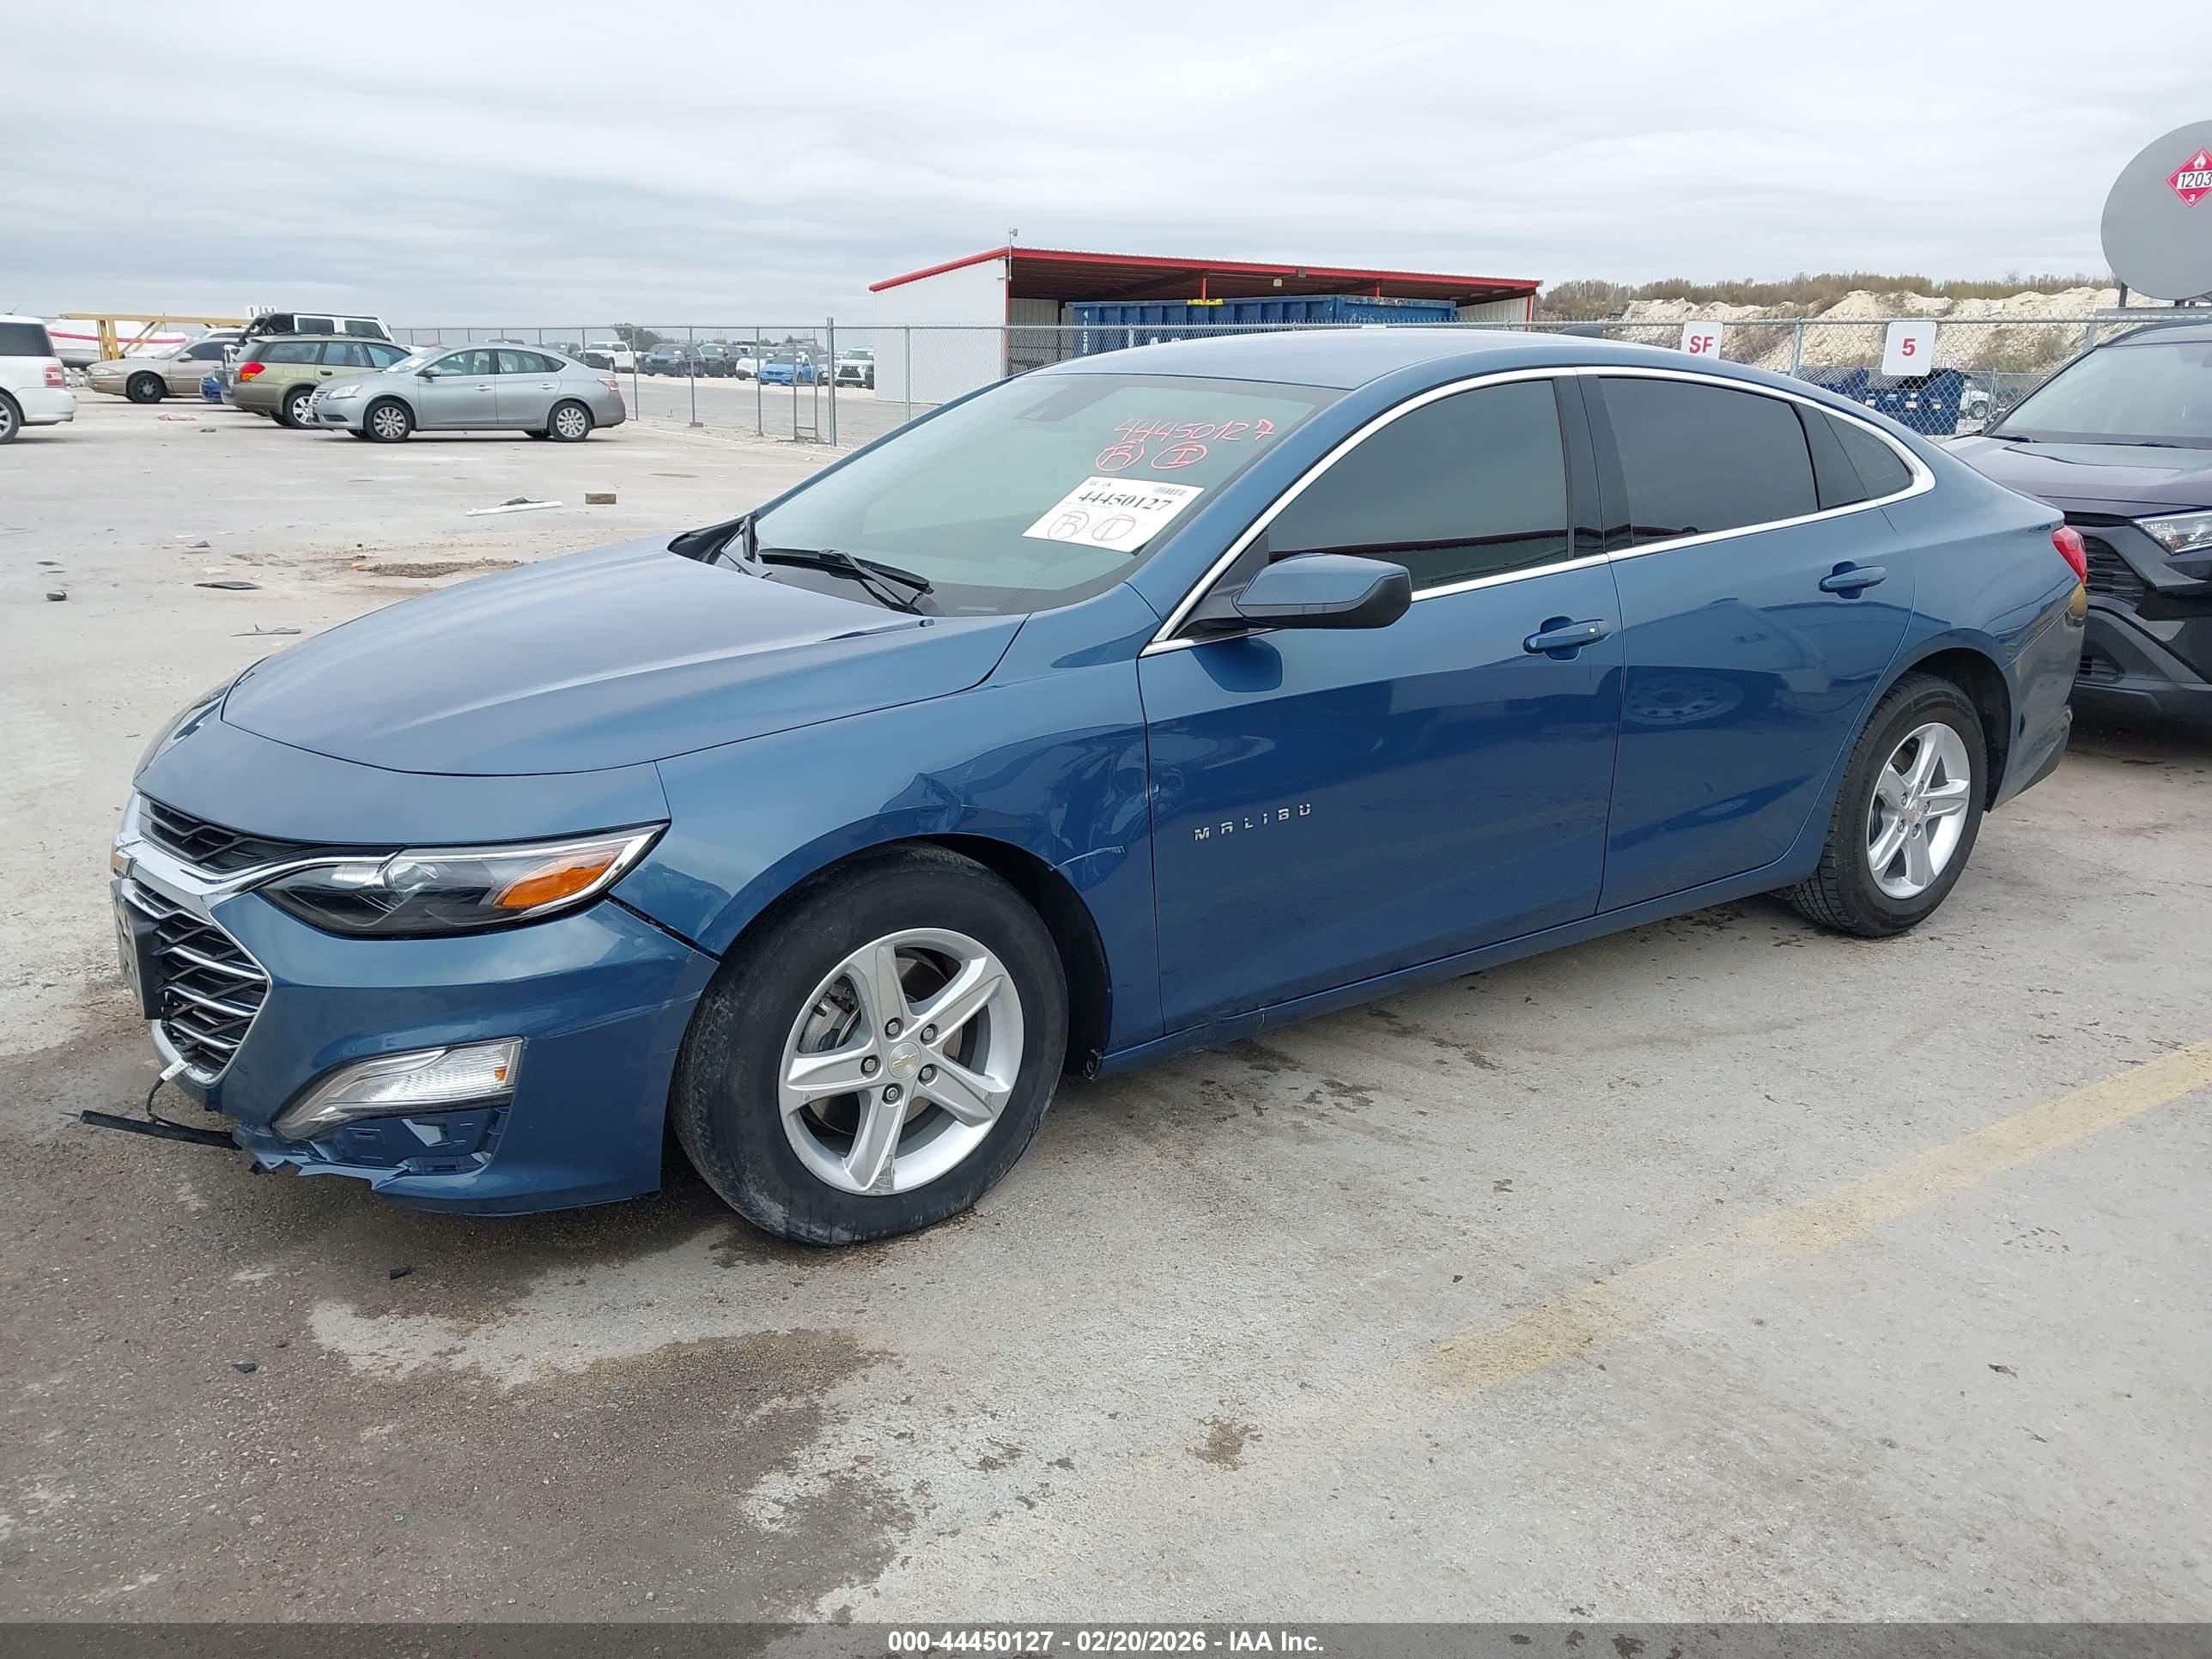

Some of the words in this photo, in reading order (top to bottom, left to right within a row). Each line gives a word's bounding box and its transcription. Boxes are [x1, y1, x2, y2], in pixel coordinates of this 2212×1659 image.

[2181, 172, 2212, 188] 1203
[2188, 193, 2196, 203] 3
[1689, 335, 1714, 354] SF
[1902, 337, 1917, 356] 5
[1079, 490, 1174, 512] 44450127
[1194, 803, 1311, 841] MALIBU
